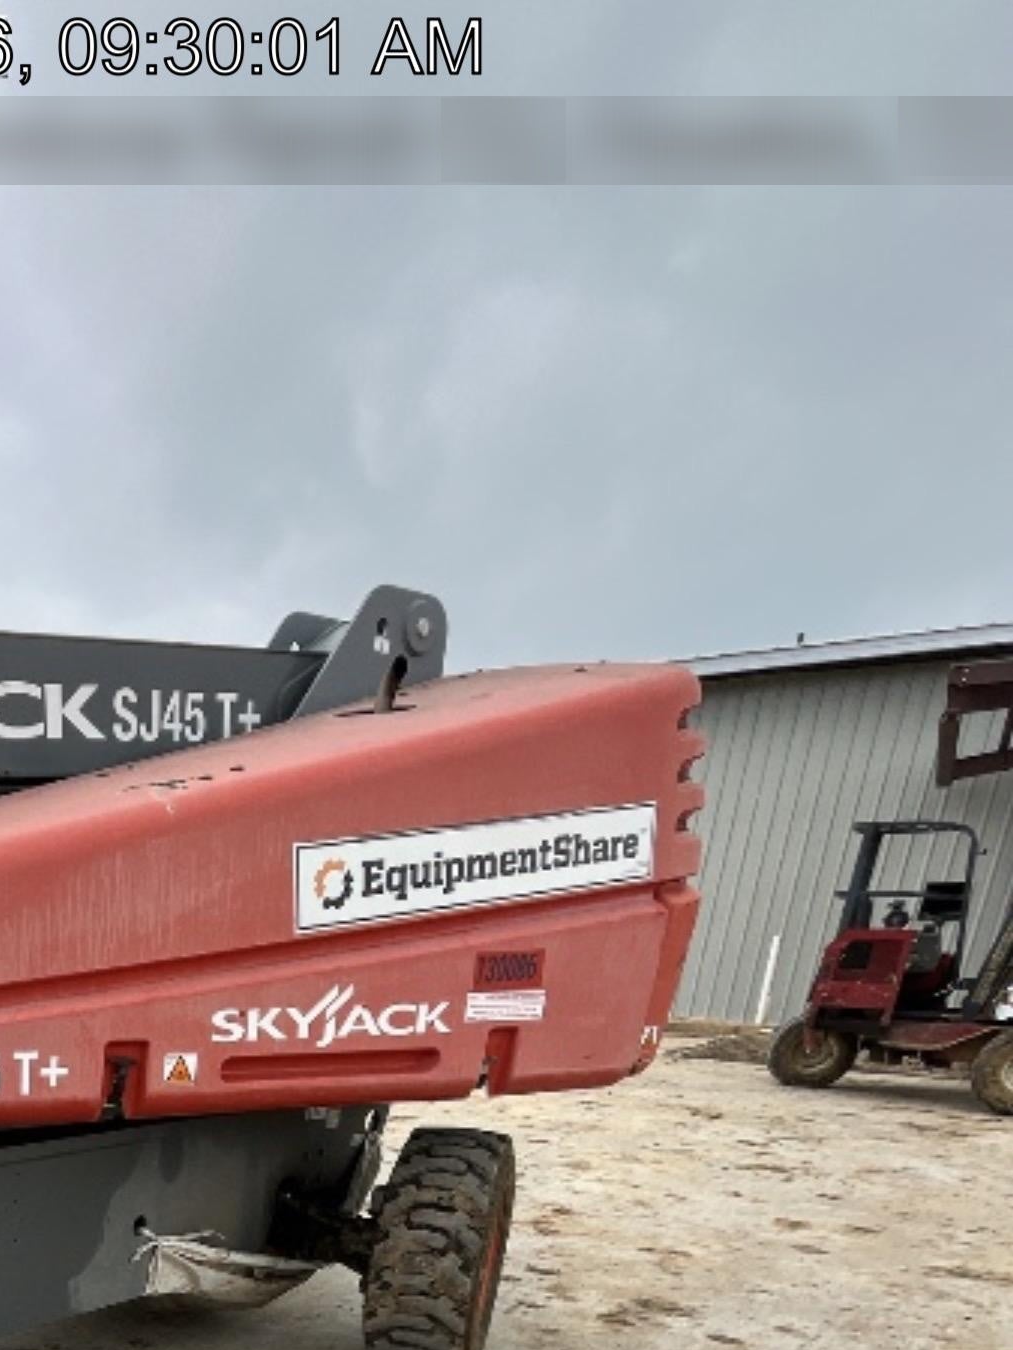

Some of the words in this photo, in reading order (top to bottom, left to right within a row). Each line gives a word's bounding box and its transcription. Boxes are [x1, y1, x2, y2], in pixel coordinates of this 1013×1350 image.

[111, 688, 205, 744] SJ45
[215, 694, 262, 740] T+
[361, 832, 639, 901] EquipmentShare
[13, 1050, 69, 1096] T+
